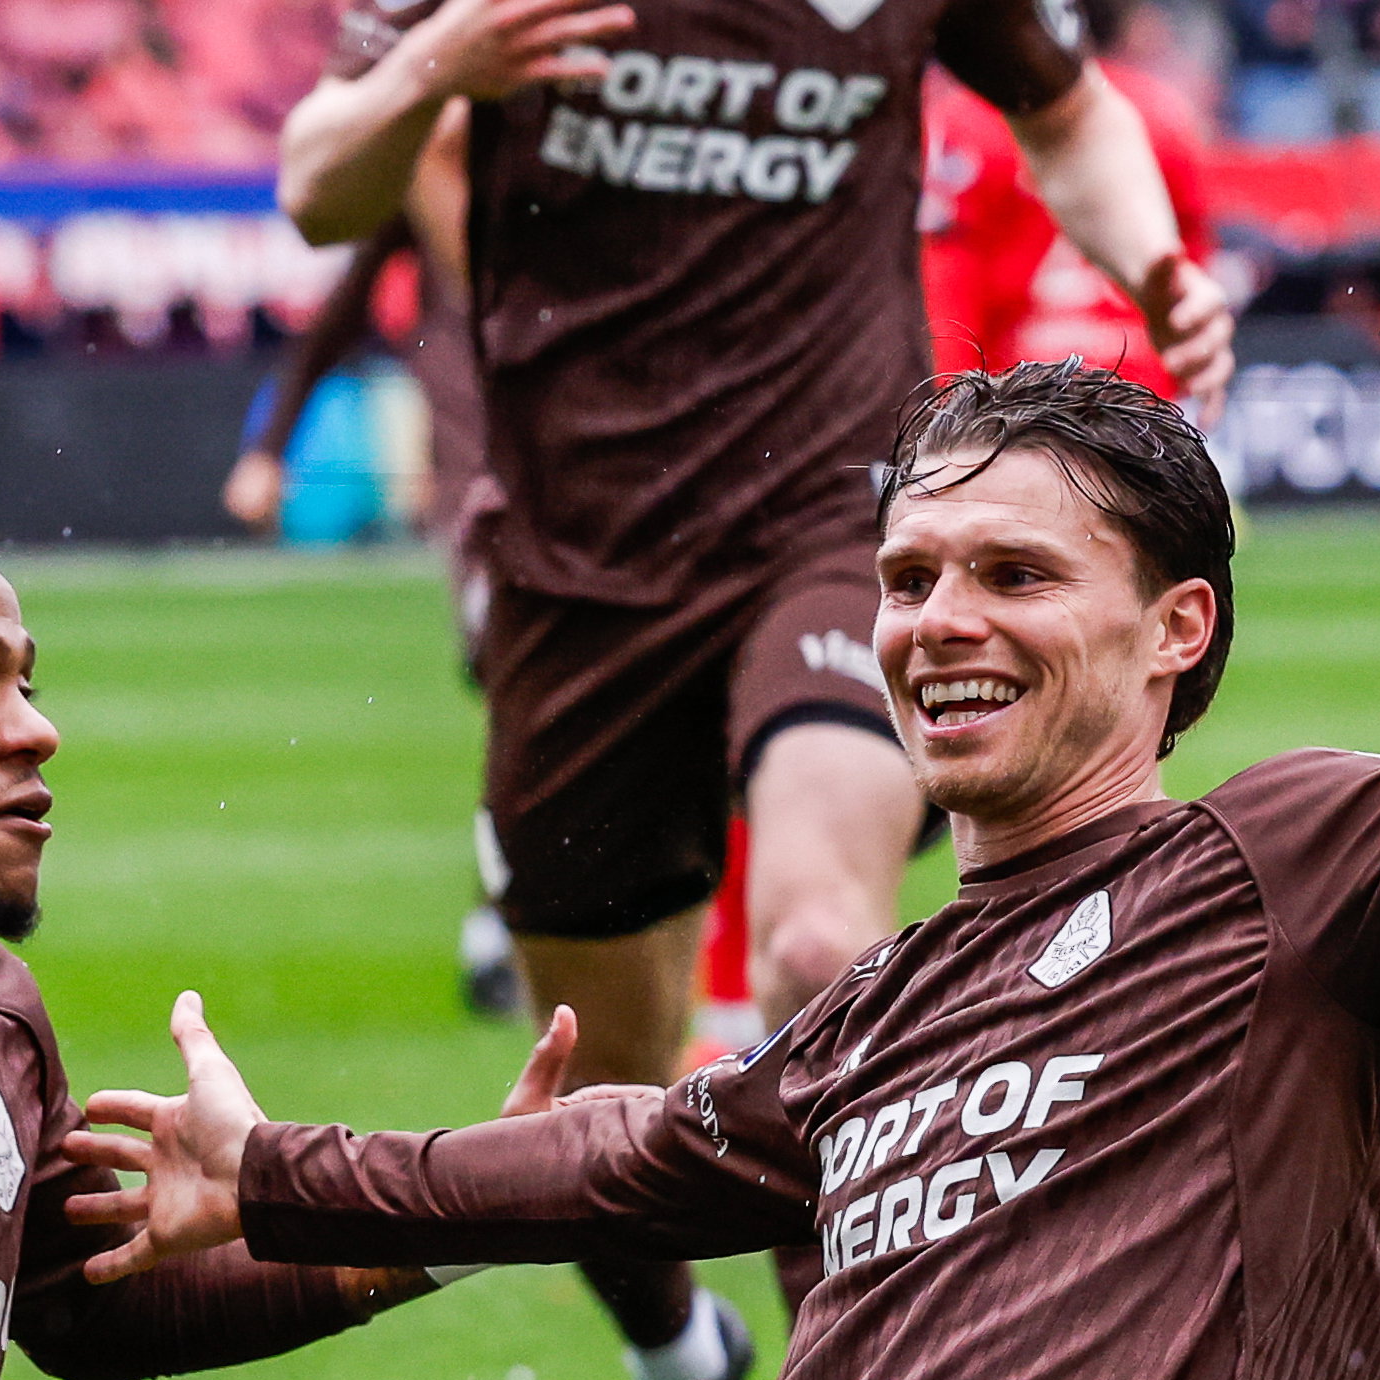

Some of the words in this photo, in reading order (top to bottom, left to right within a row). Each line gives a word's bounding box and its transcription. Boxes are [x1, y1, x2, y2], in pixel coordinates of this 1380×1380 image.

[563, 47, 776, 125] ORT
[774, 68, 887, 135] OF
[541, 104, 858, 203] ENERGY
[961, 1053, 1106, 1136] OF
[823, 1148, 1067, 1280] NERGY
